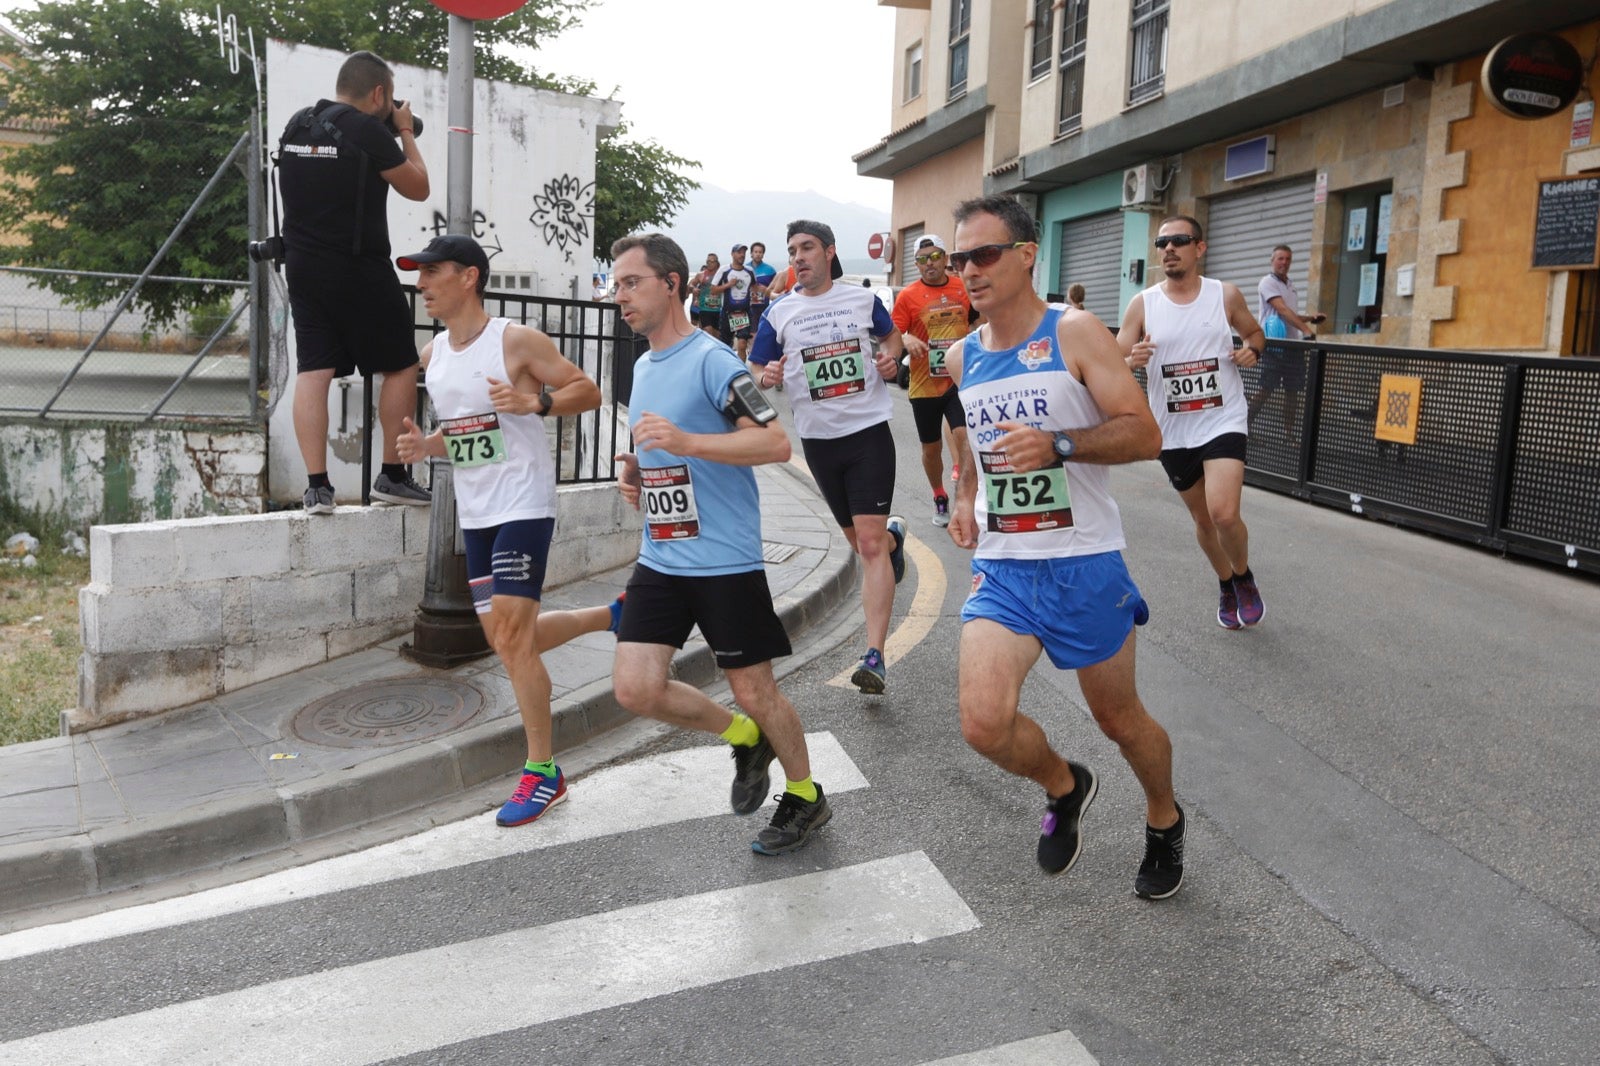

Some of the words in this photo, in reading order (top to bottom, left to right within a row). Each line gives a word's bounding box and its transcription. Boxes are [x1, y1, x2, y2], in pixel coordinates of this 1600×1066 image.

[804, 314, 825, 324] PRUEBA
[833, 309, 852, 318] FONDO
[815, 357, 857, 382] 403
[988, 388, 1048, 404] ATLETISMO
[1170, 374, 1218, 396] 3014
[966, 398, 1050, 429] CAXAR
[451, 435, 495, 462] 273
[991, 454, 1006, 464] GRAN
[643, 489, 689, 515] 009
[991, 475, 1055, 508] 752
